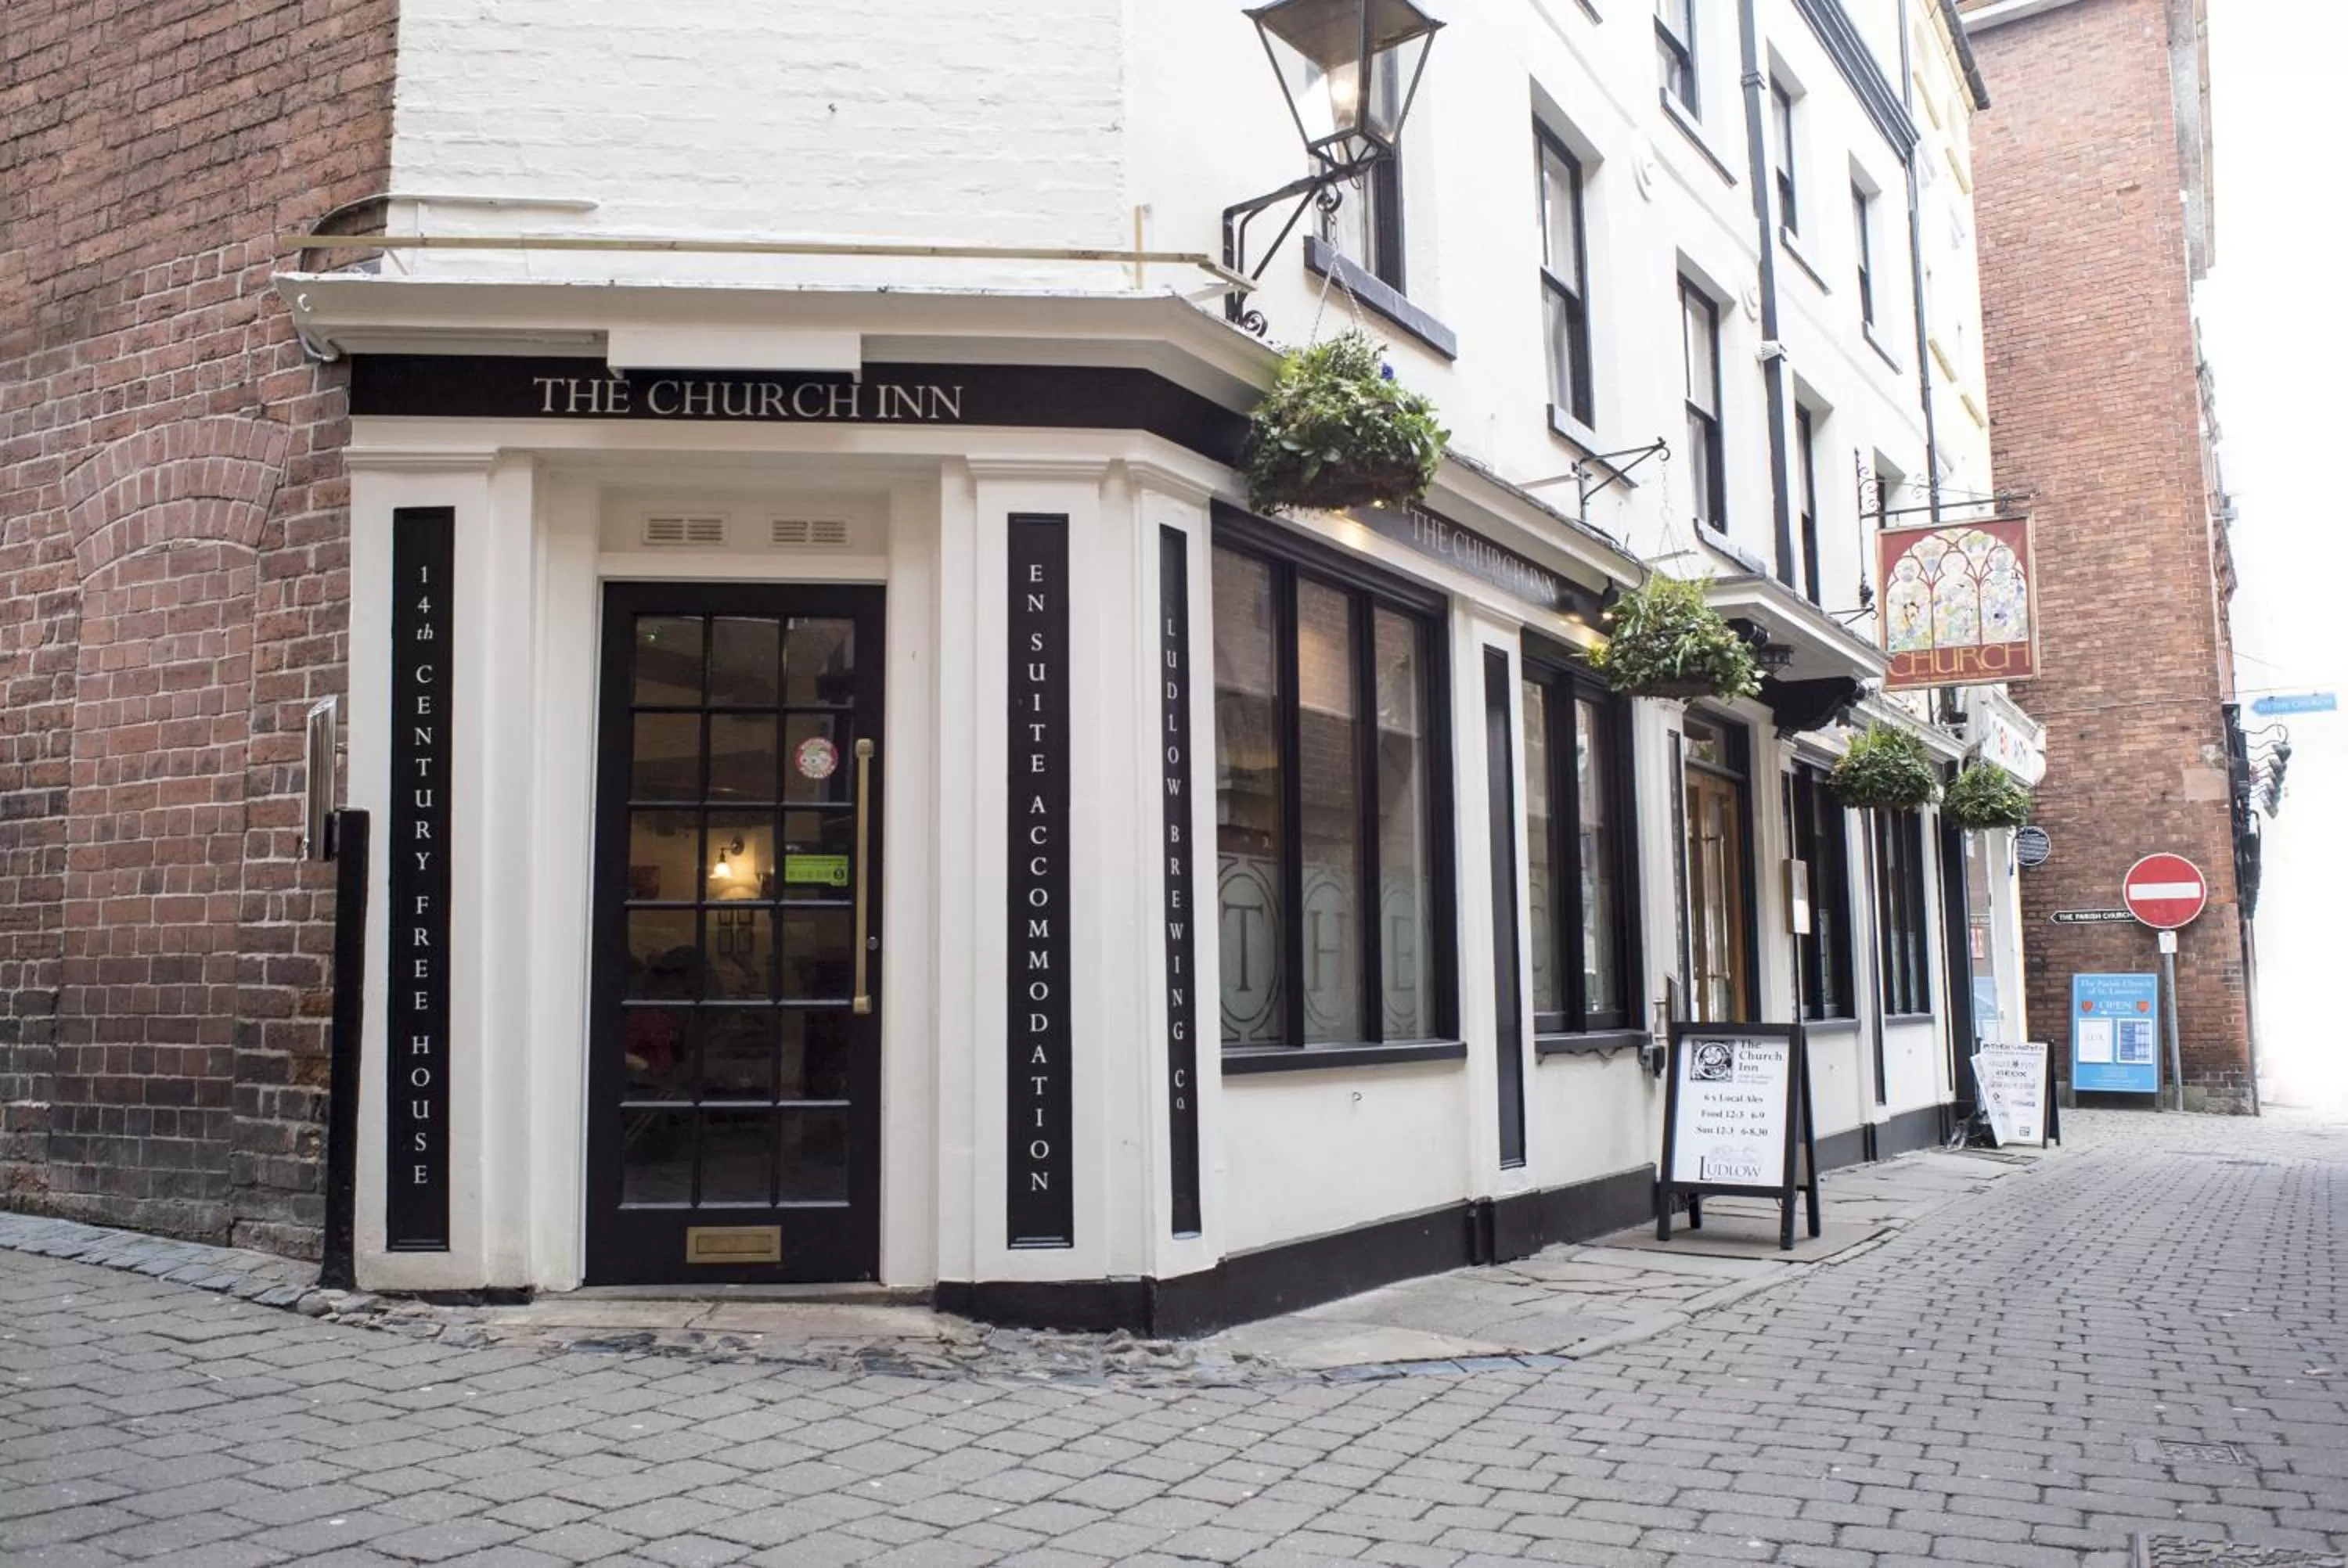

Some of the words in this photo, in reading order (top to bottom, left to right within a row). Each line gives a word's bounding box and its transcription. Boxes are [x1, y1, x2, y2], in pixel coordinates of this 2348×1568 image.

[534, 378, 631, 414] THE
[648, 380, 861, 419] CHURCH
[876, 385, 963, 419] INN
[1411, 509, 1448, 552] THE
[1453, 530, 1525, 589] CHURCH
[1027, 565, 1046, 613] EN
[1888, 643, 2030, 678] CHURCH
[1028, 633, 1046, 773] SUITE
[1166, 618, 1181, 795] LUDLOW
[414, 665, 433, 871] CENTURY
[414, 896, 431, 1011] FREE
[1170, 825, 1184, 1041] BREWING
[1028, 796, 1050, 1191] ACCOMMODATION
[1738, 1063, 1759, 1072] Inn
[1739, 1051, 1782, 1062] Church
[1740, 1038, 1762, 1049] The
[411, 1036, 431, 1184] HOUSE
[1701, 1109, 1723, 1118] Food
[1720, 1094, 1743, 1102] Local
